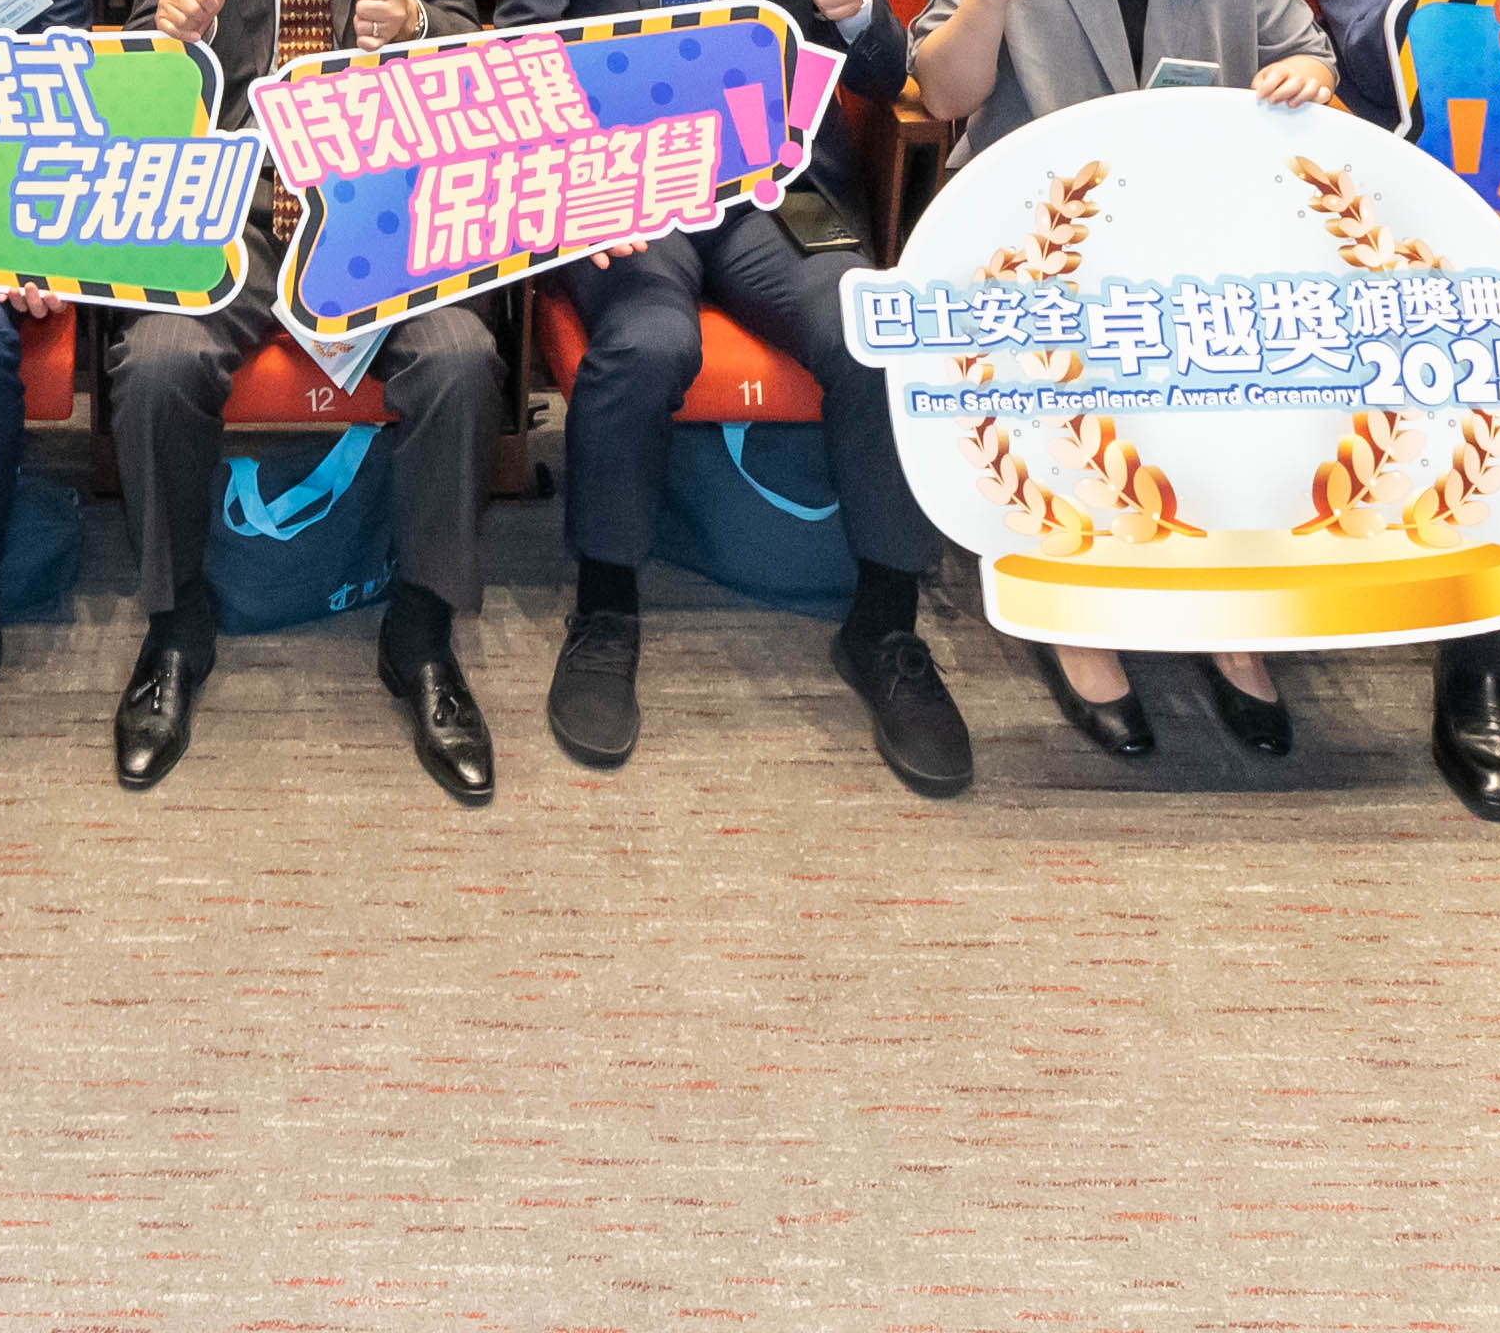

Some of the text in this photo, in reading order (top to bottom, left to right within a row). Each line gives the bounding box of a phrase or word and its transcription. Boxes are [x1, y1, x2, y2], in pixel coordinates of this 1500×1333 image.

[260, 36, 593, 181] 時刻忍讓
[16, 141, 256, 242] 守規則
[413, 117, 716, 270] 保持警覺
[306, 386, 337, 413] 12
[738, 380, 763, 406] 11
[913, 382, 1361, 416] Bus Safety Excellence Award Ceremony
